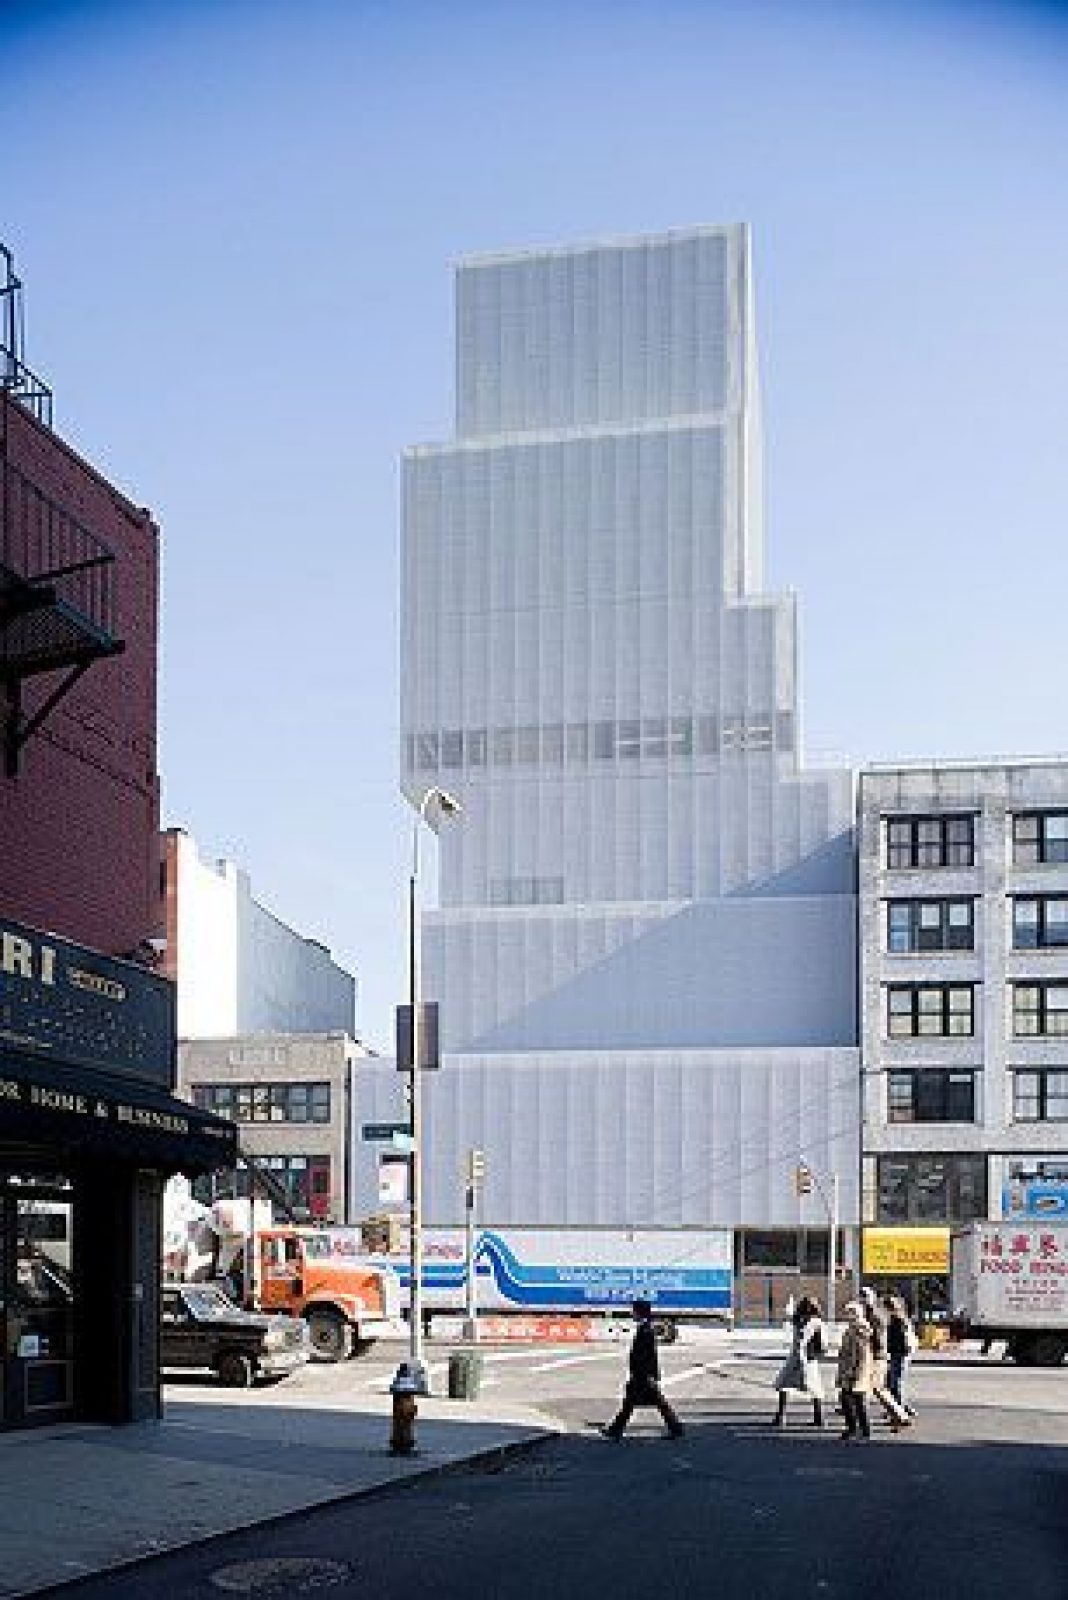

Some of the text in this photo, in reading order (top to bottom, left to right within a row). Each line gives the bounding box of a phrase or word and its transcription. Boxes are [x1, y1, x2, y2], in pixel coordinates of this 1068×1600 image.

[3, 931, 56, 986] RI
[30, 1084, 87, 1113] HOME
[94, 1101, 108, 1117] &
[117, 1105, 189, 1134] BUSINESS
